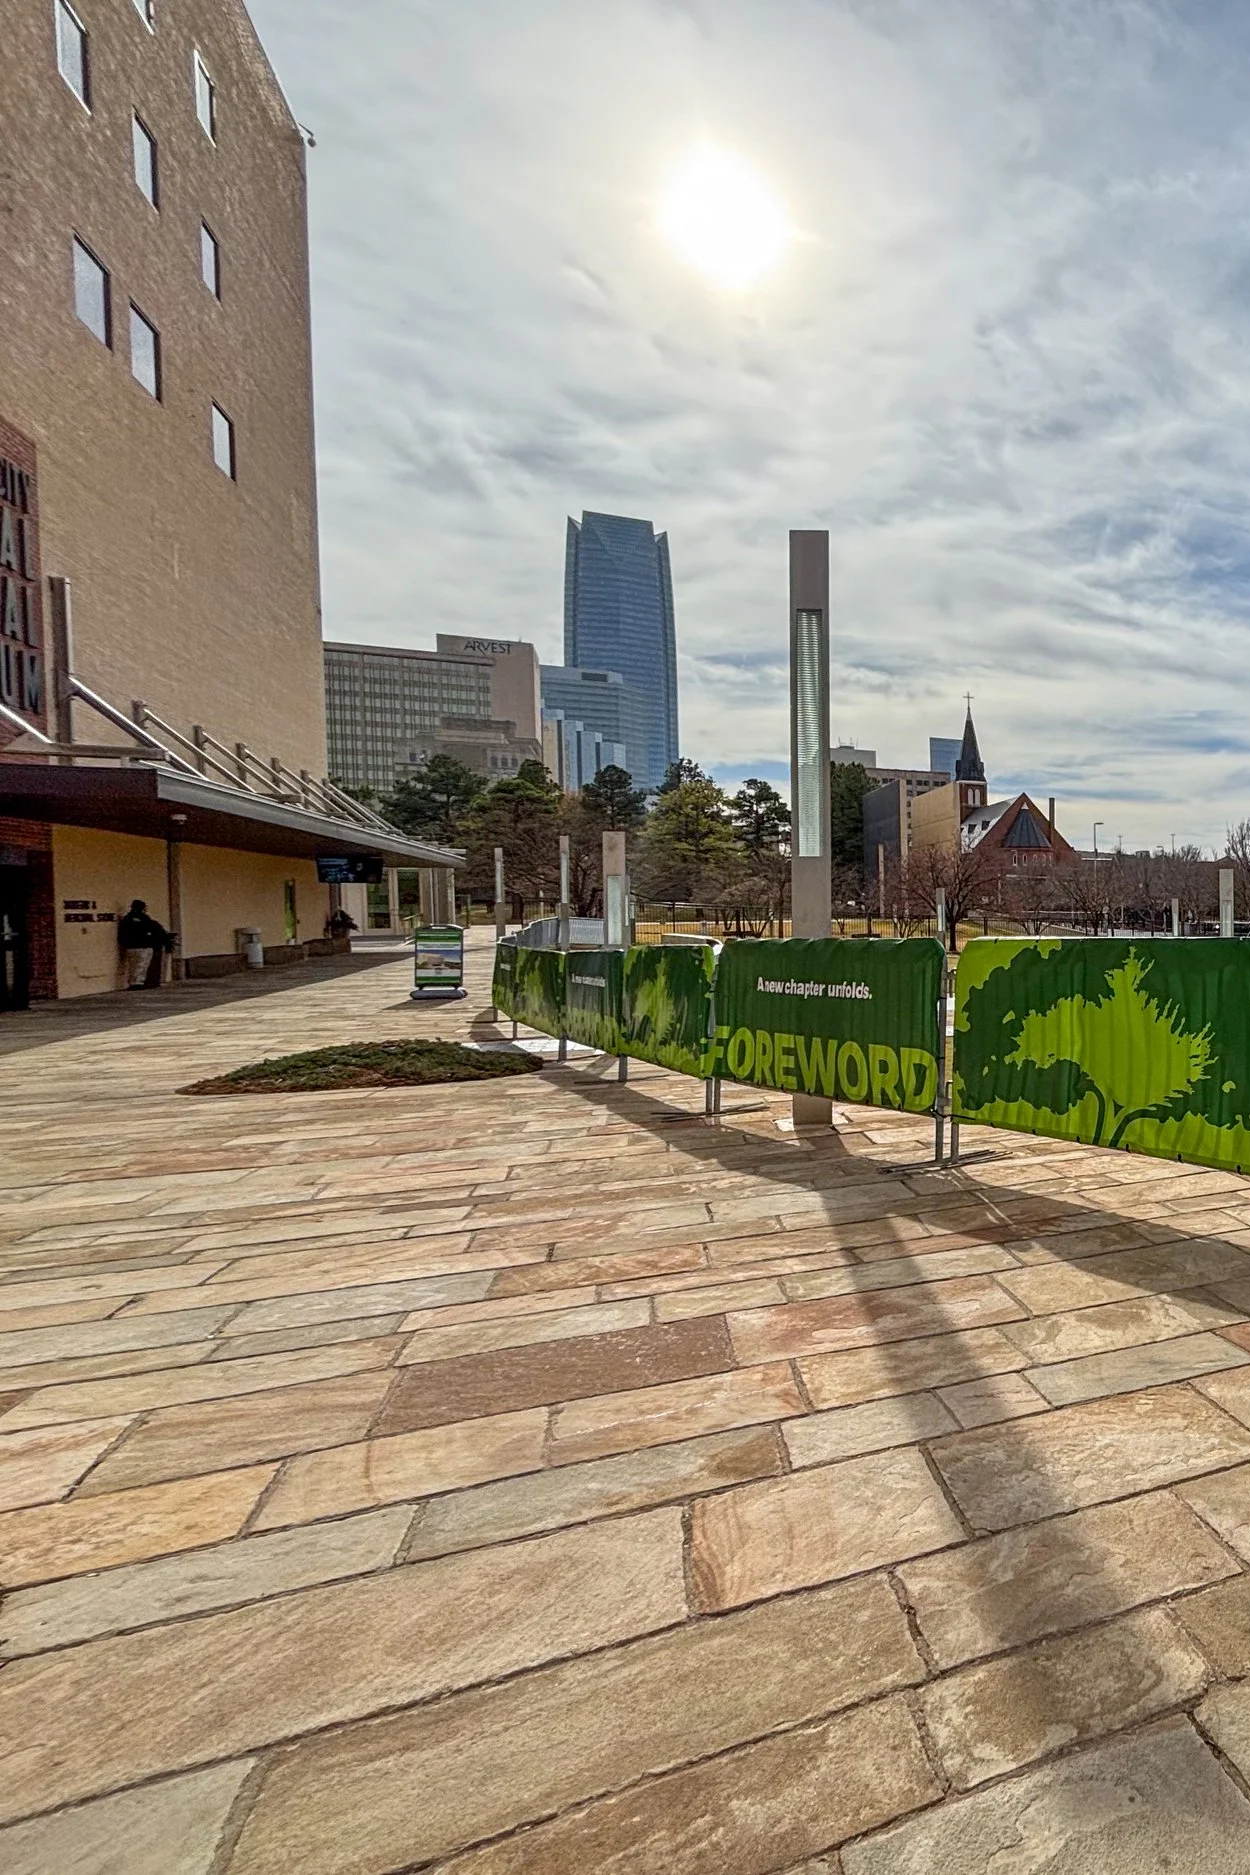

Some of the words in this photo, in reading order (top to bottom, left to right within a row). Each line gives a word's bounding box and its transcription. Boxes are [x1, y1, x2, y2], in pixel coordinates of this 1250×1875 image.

[464, 640, 511, 656] ARVEST
[757, 976, 765, 992] A
[765, 980, 785, 994] new
[784, 978, 826, 999] chapter
[828, 981, 873, 1000] unfolds.
[708, 1025, 939, 1112] FOREWORD
